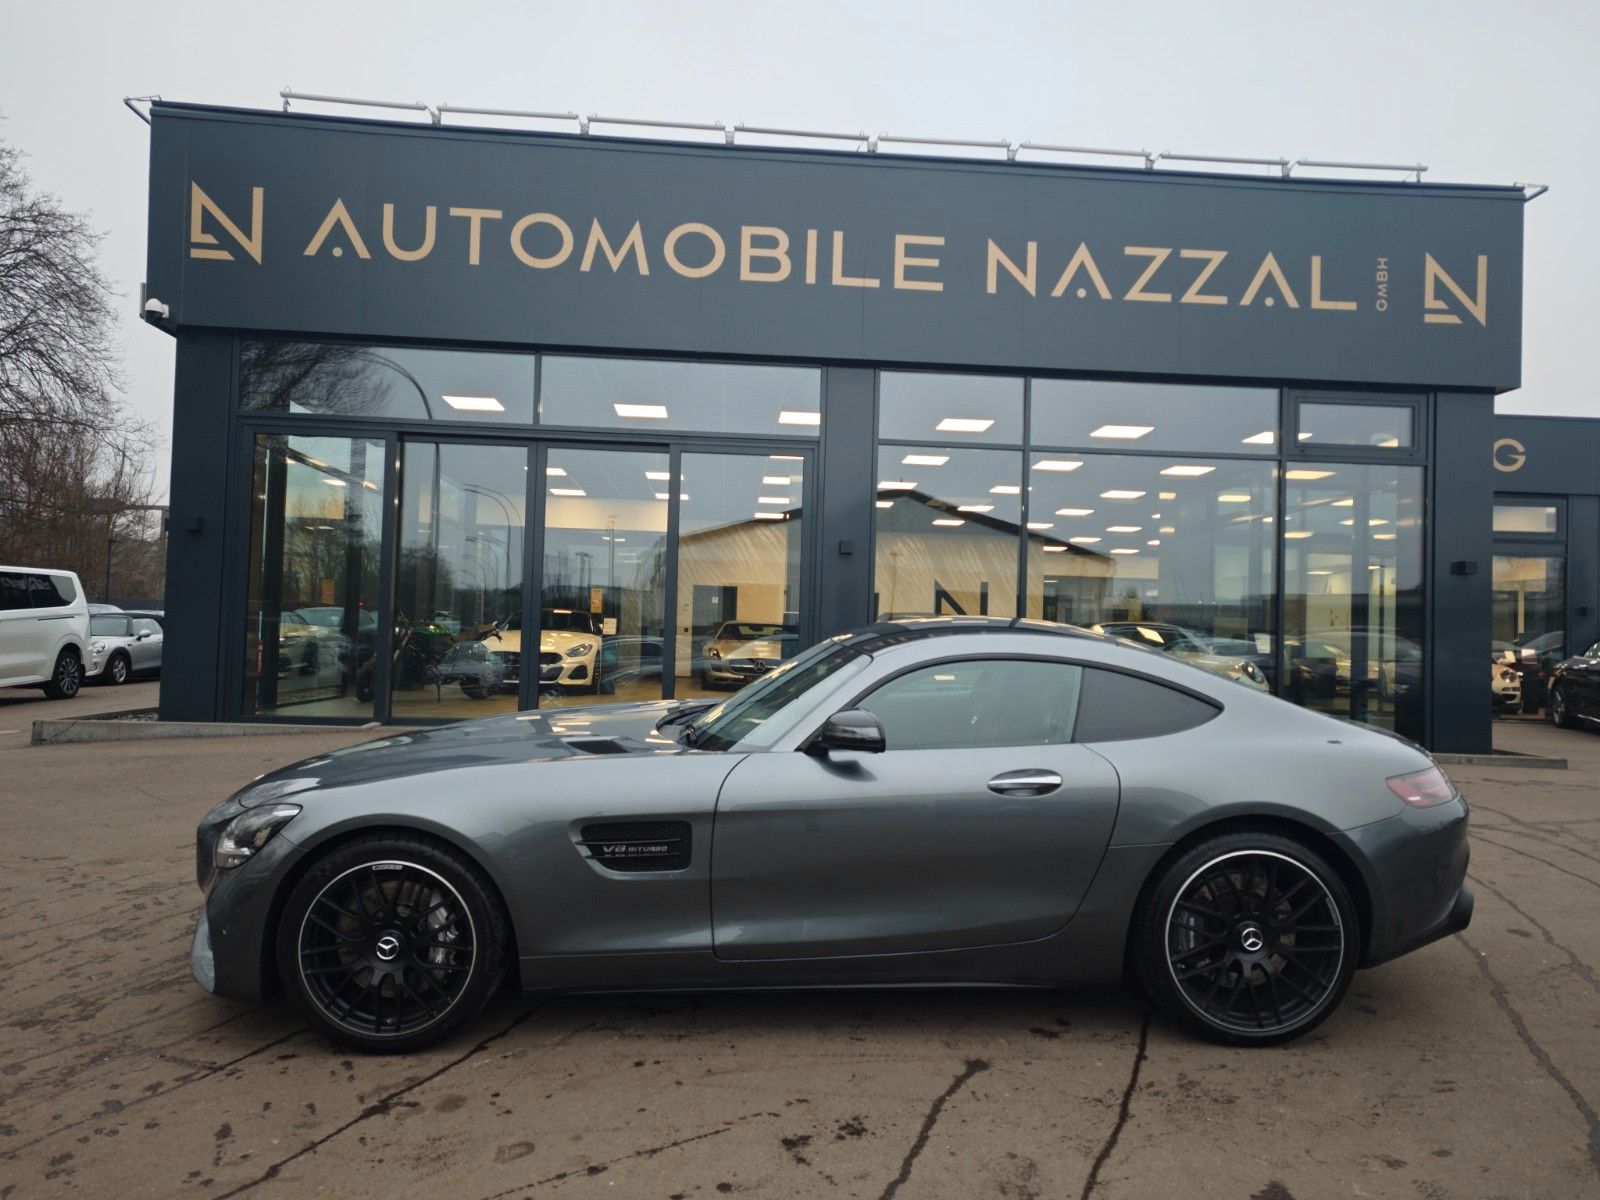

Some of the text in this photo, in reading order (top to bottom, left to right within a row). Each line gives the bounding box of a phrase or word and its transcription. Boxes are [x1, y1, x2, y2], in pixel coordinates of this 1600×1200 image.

[304, 198, 1358, 311] AUTOMOBILE NAZZAL
[1376, 256, 1389, 312] GMBH
[1494, 438, 1527, 473] G
